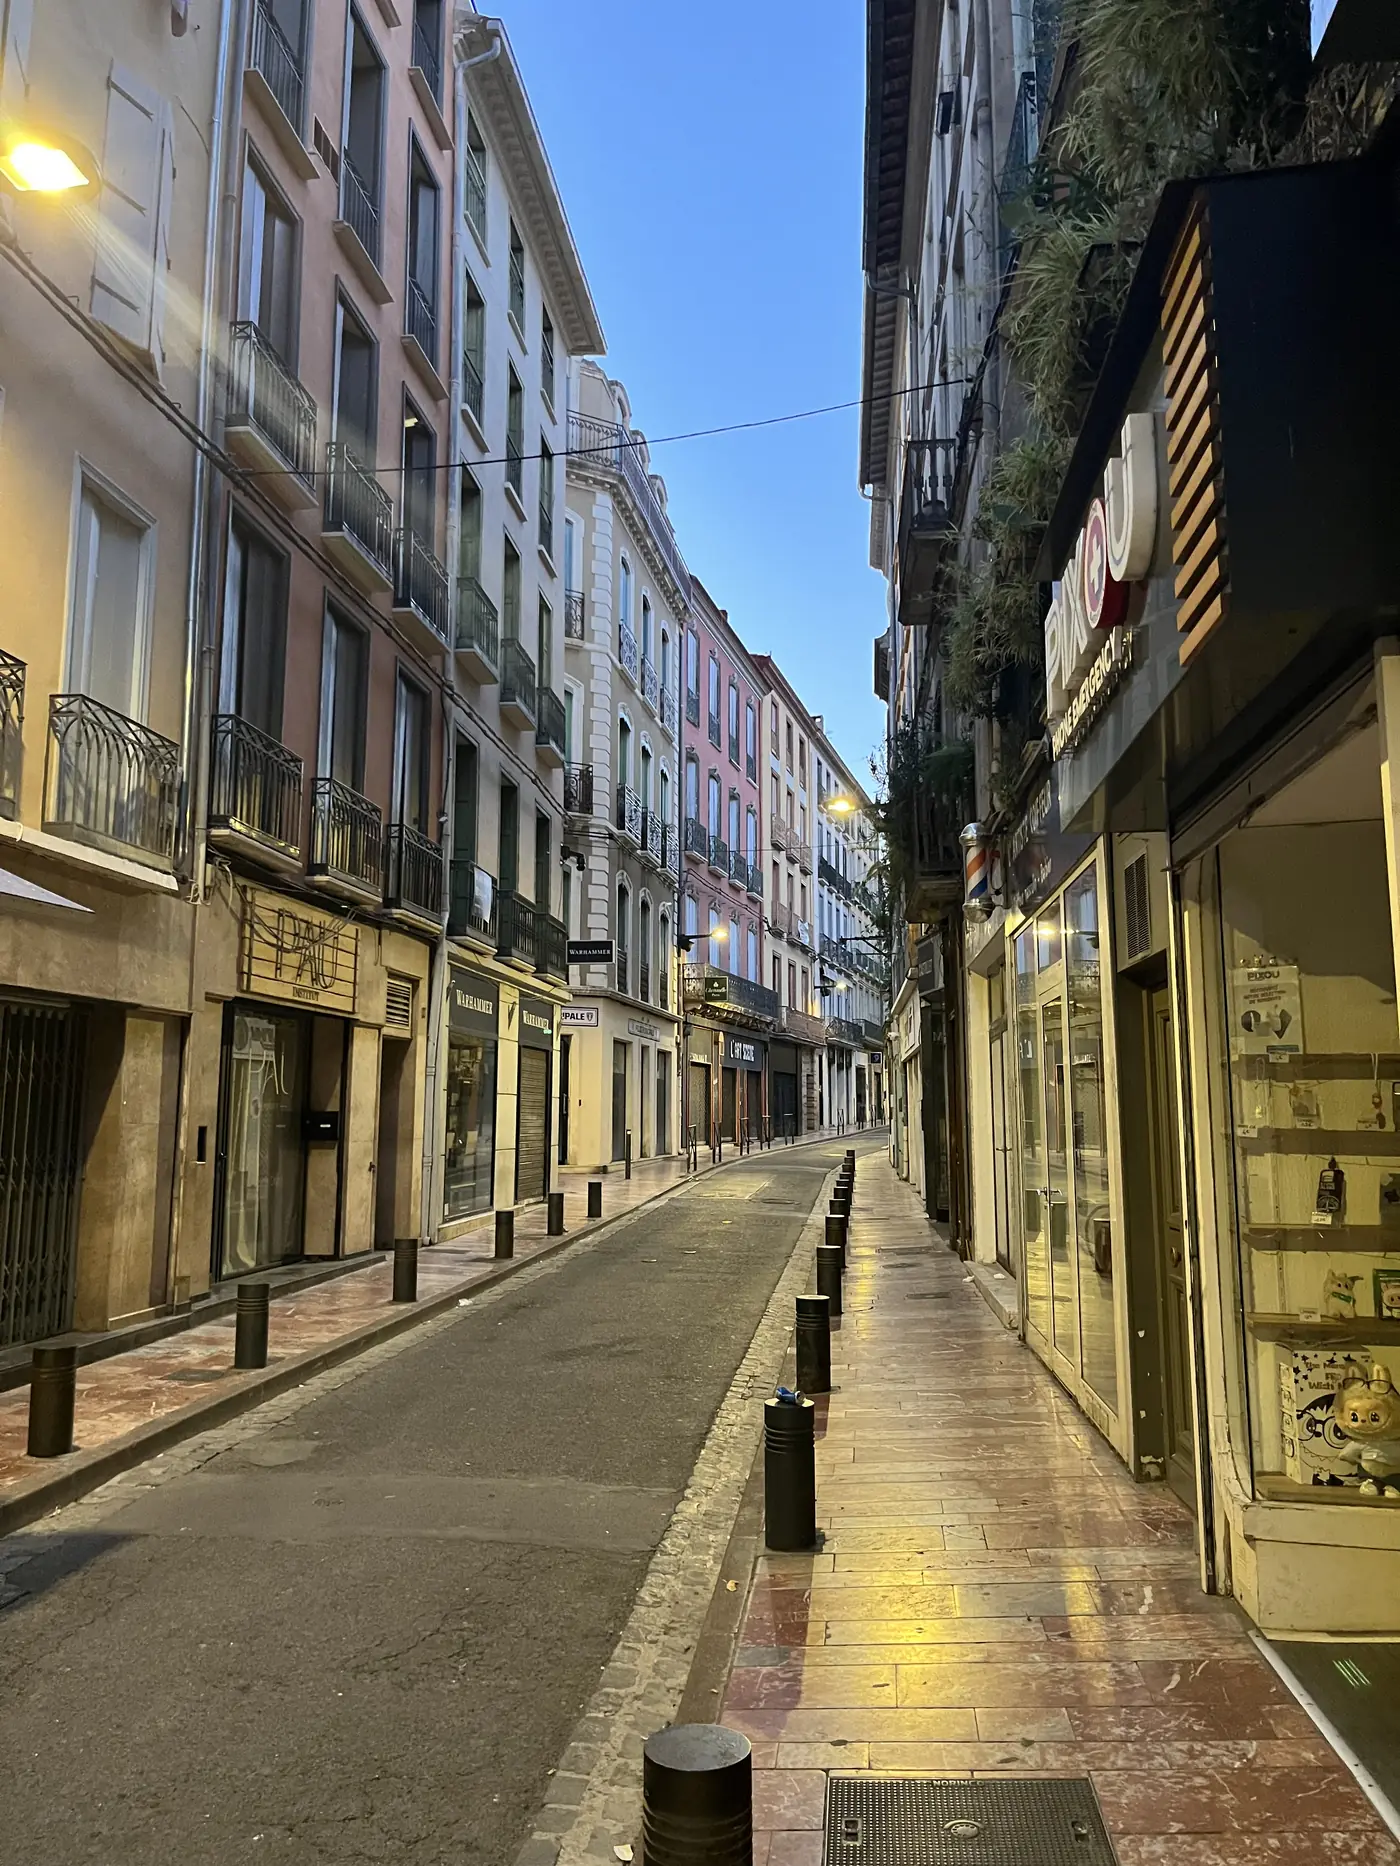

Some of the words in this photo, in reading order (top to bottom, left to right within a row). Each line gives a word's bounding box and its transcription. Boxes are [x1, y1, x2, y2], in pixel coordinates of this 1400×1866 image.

[1052, 706, 1073, 761] PHONE
[1072, 625, 1117, 729] EMERGENCY
[456, 989, 493, 1015] WARHAMMER
[561, 1012, 585, 1020] IPALE
